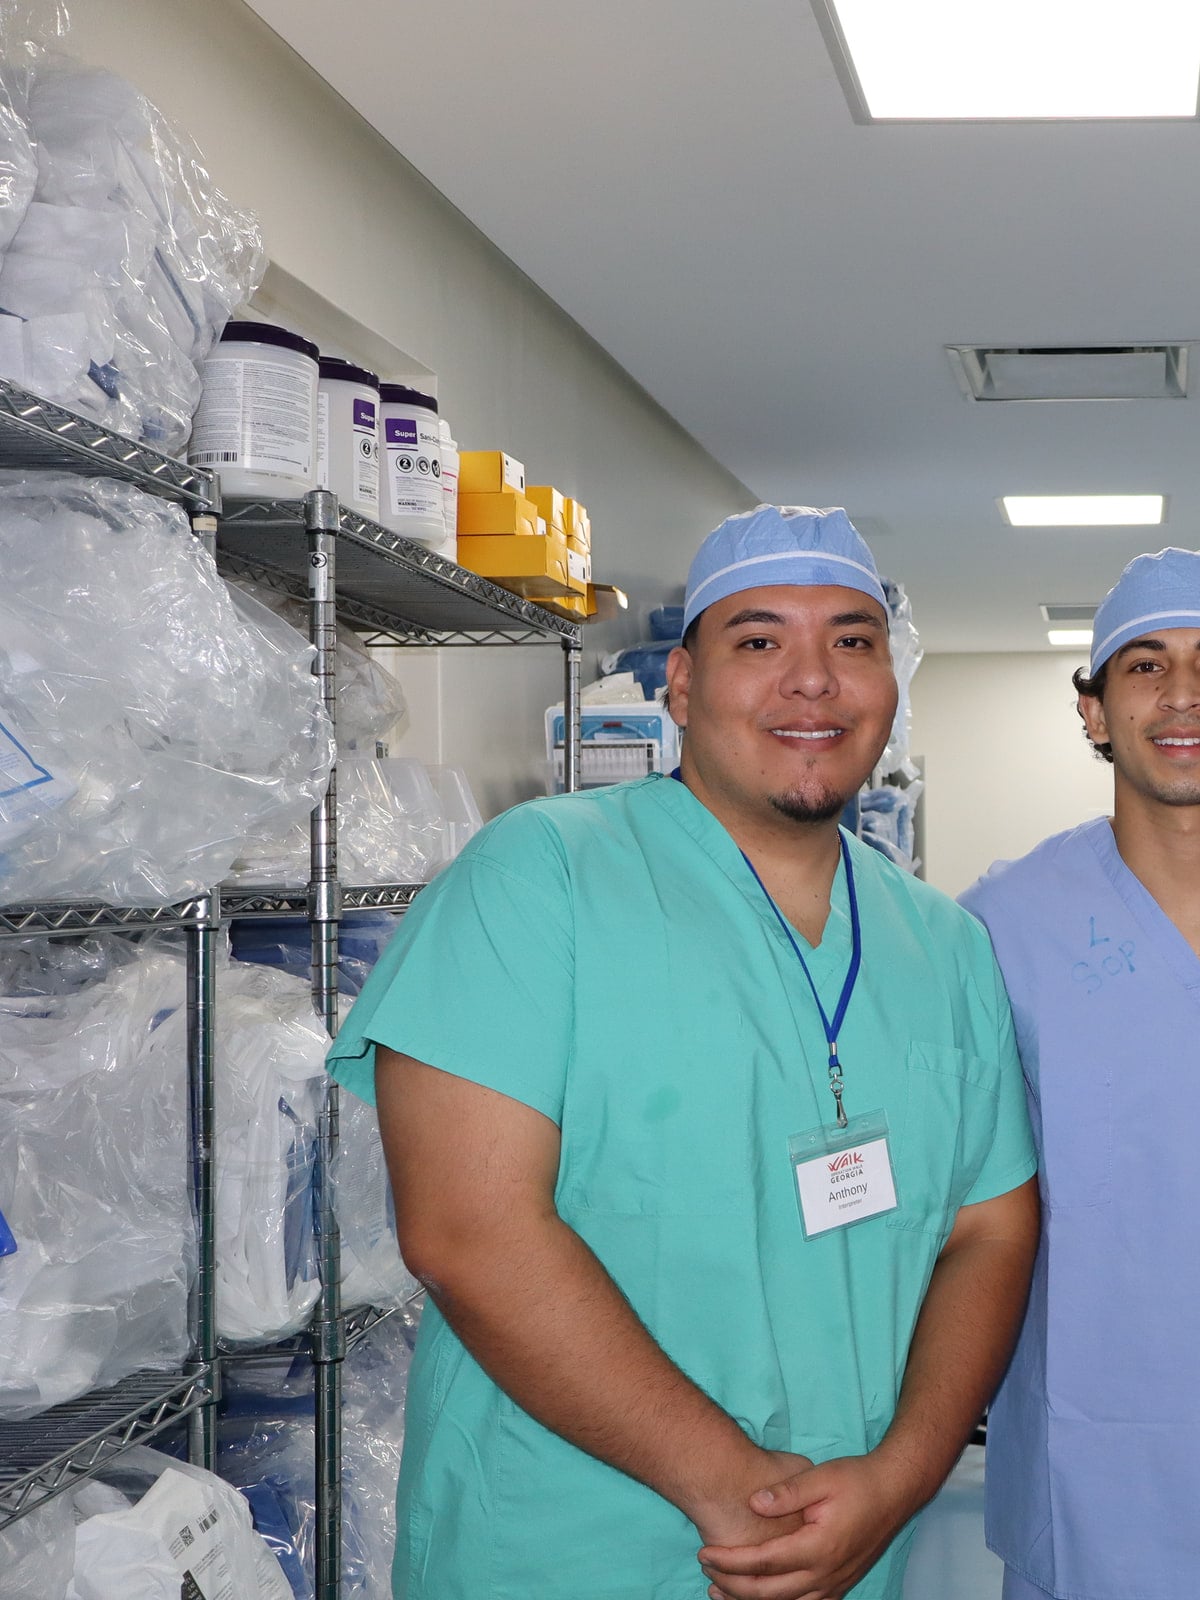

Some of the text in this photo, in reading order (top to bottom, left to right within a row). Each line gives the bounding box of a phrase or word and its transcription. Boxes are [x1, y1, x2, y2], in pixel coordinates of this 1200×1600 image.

[395, 429, 416, 438] Super
[1089, 915, 1110, 948] L
[830, 1169, 864, 1184] GEORGIA
[828, 1182, 868, 1203] Anthony
